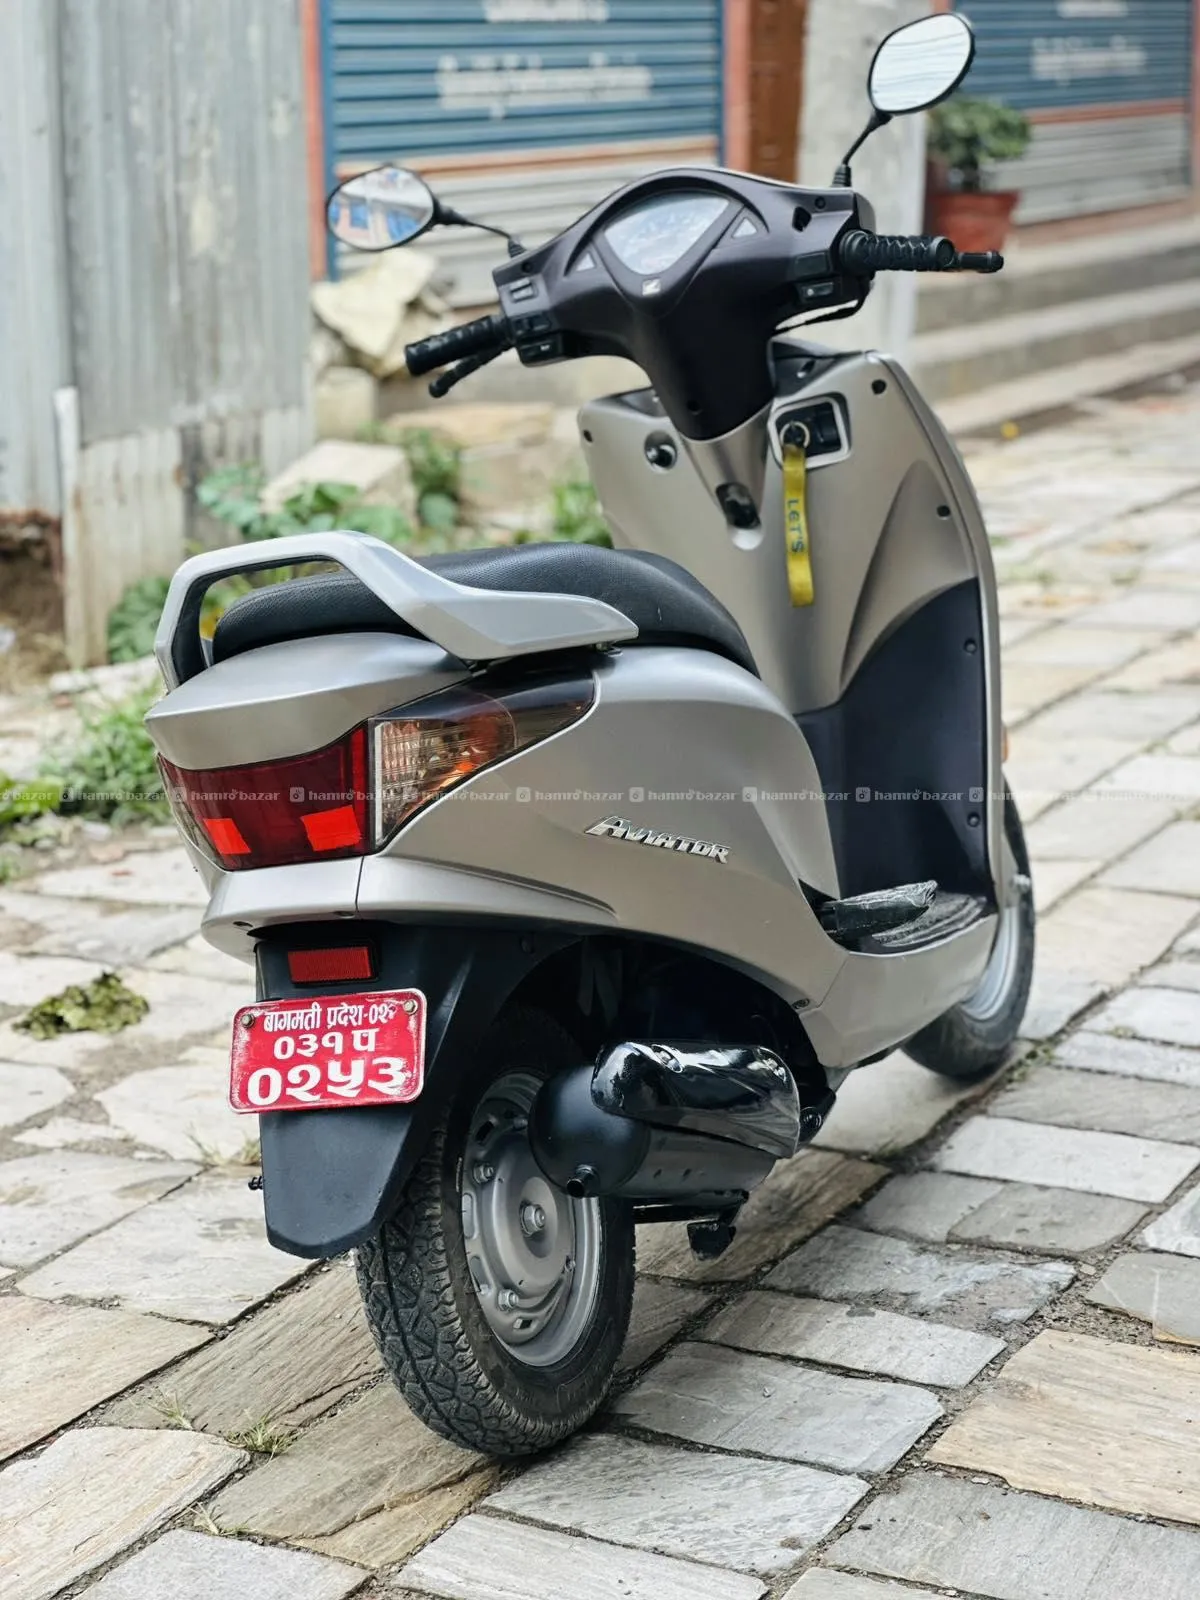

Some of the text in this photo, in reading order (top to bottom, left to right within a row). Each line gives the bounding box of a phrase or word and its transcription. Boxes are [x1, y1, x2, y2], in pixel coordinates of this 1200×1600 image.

[584, 815, 732, 864] AVIATOR
[263, 1001, 322, 1032] बागमती
[273, 1027, 380, 1060] ०३१ प
[247, 1056, 408, 1106] ०२५३
